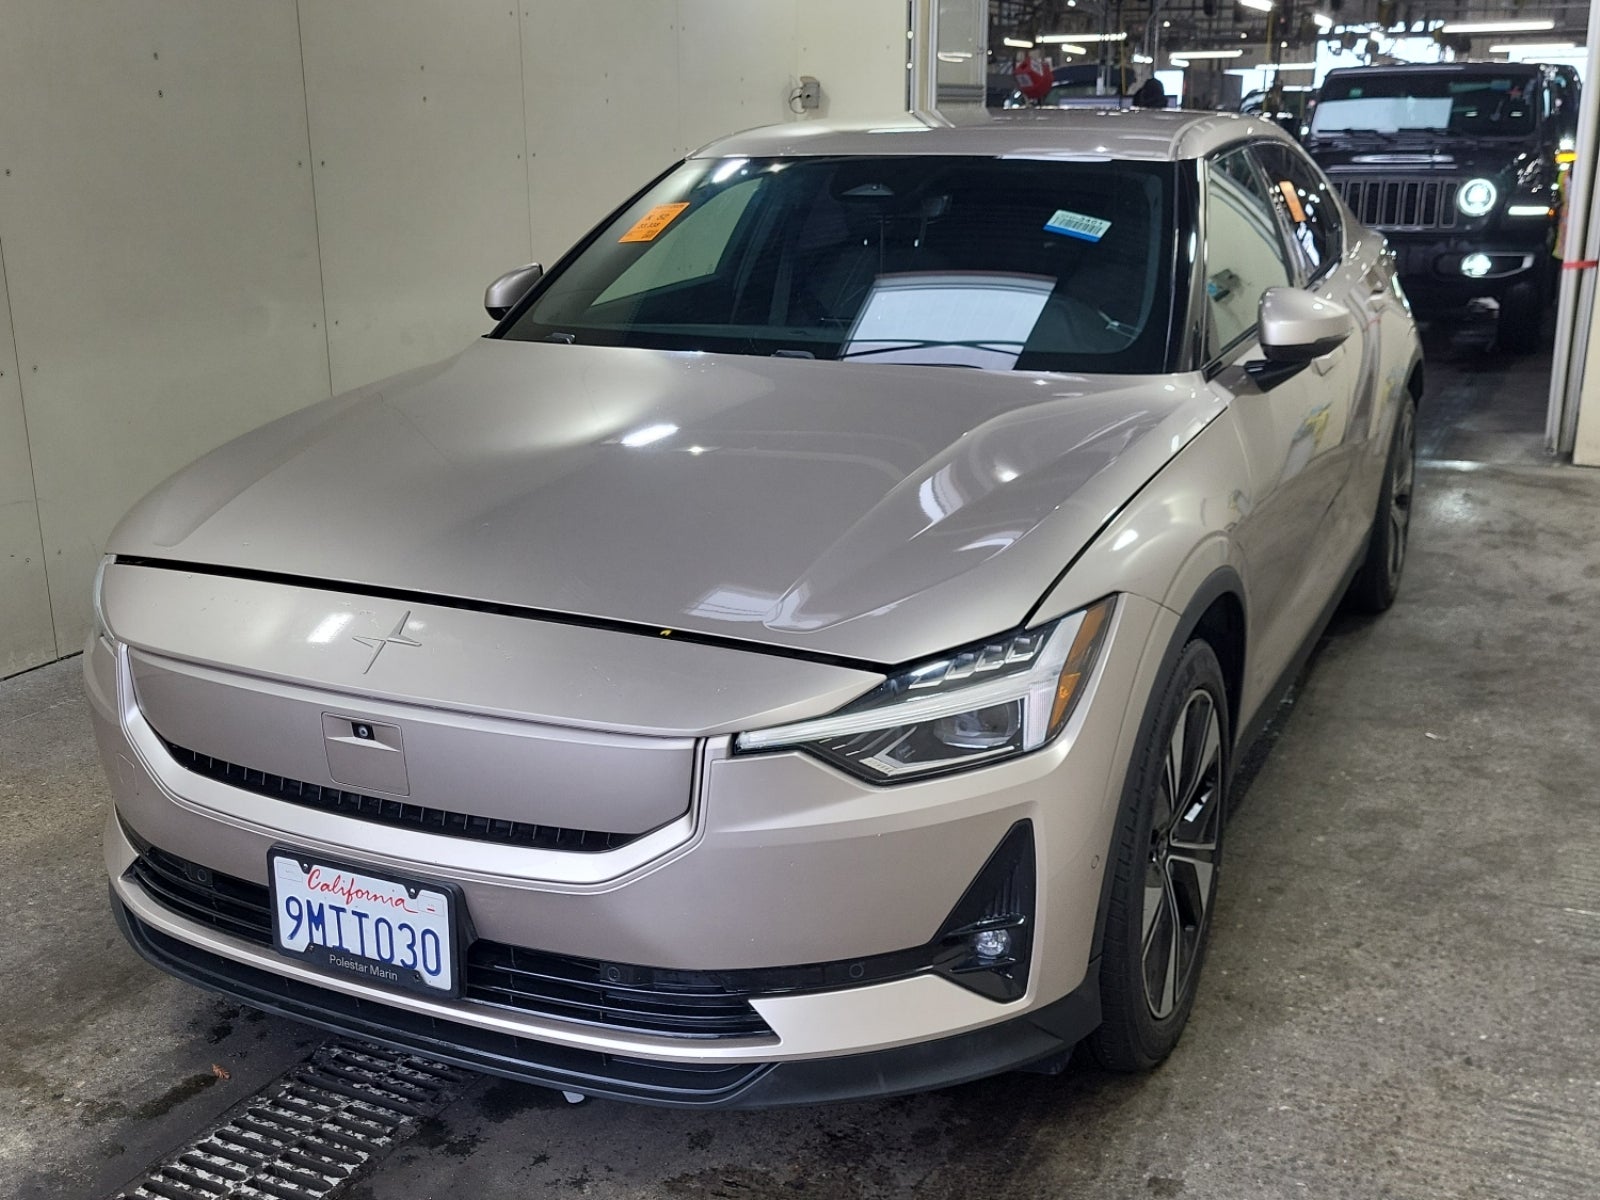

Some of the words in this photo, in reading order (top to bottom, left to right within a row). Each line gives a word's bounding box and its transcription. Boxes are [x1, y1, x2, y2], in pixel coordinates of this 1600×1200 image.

[307, 868, 419, 914] California
[285, 895, 441, 977] 9MIT030
[329, 954, 368, 973] Polestar
[369, 963, 398, 982] Marin
